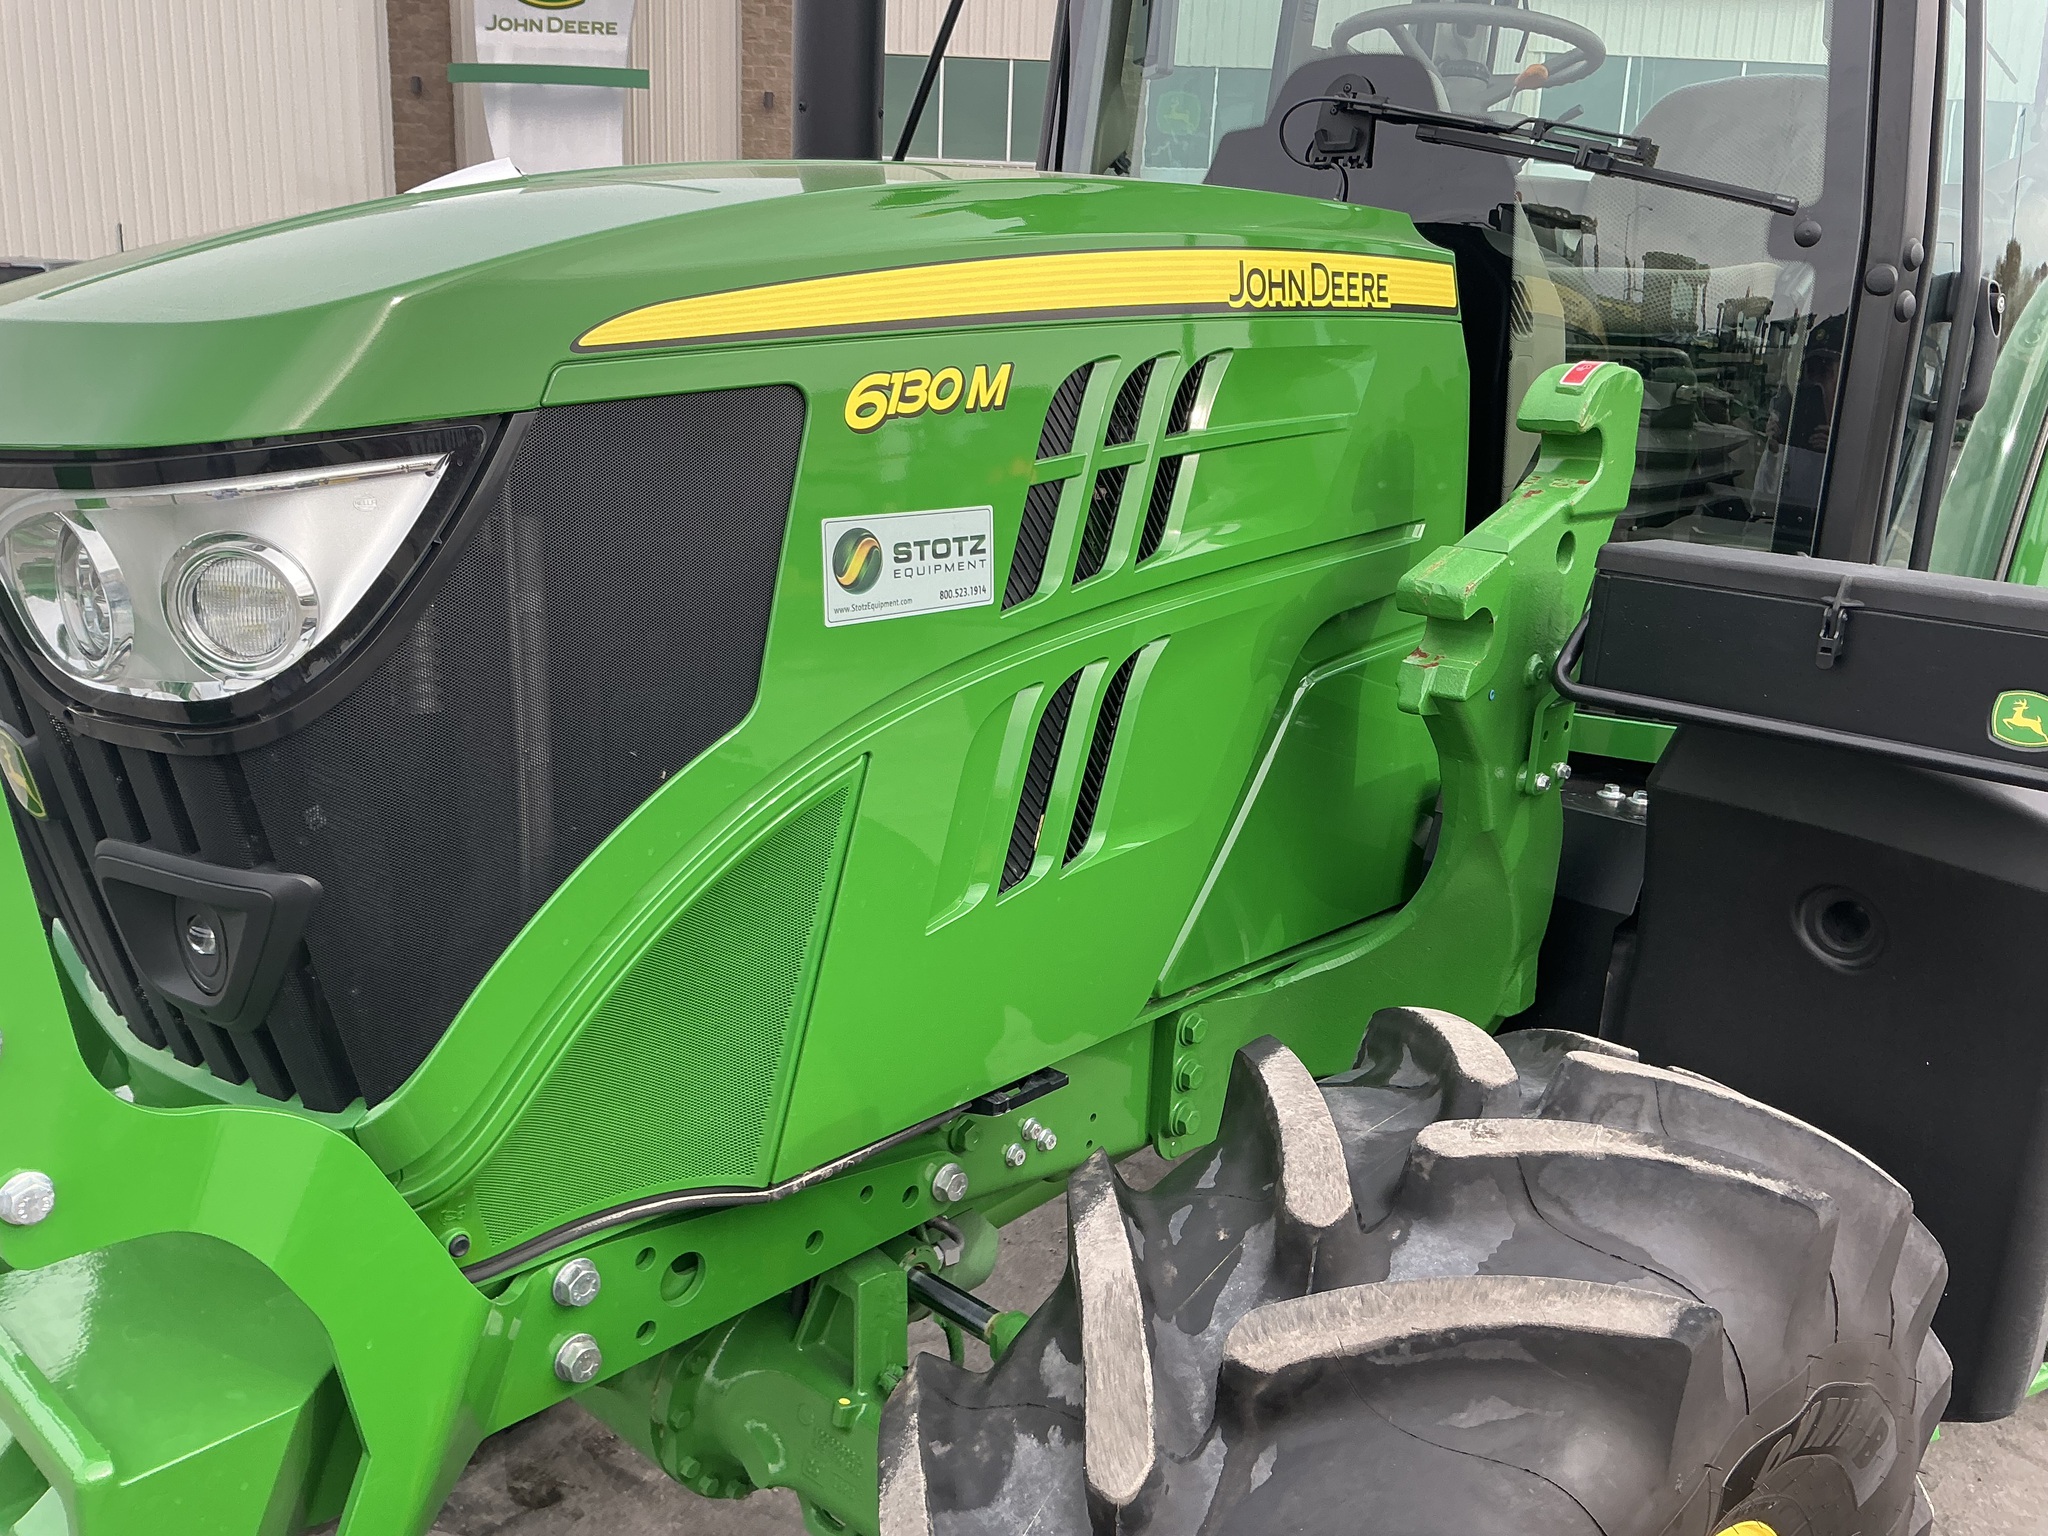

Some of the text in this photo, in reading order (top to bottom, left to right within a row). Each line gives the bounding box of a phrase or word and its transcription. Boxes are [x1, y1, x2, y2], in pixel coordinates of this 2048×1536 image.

[485, 14, 618, 35] JOHN DEERE
[1229, 259, 1390, 304] JOHN DEERE
[893, 534, 986, 564] STOTZ
[893, 559, 987, 579] EQUIPMENT
[939, 584, 987, 600] 800.523.1914
[833, 597, 913, 615] www.StotzEquipment.com
